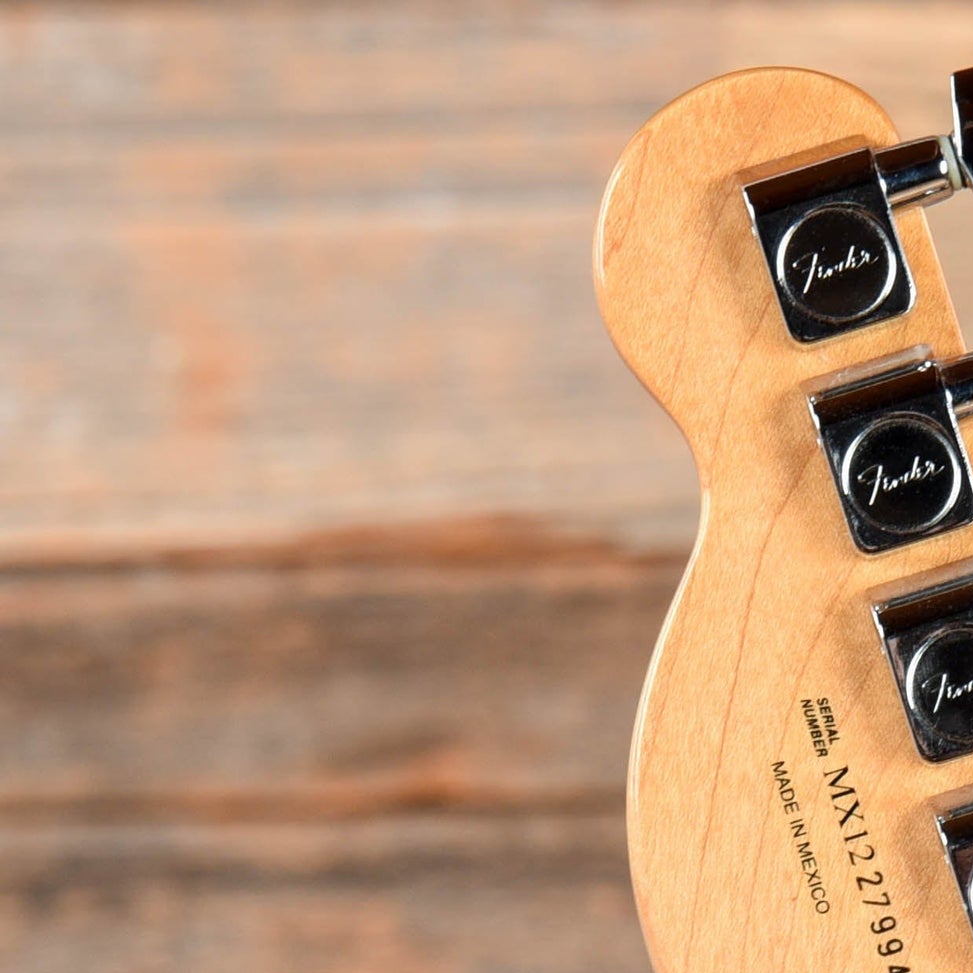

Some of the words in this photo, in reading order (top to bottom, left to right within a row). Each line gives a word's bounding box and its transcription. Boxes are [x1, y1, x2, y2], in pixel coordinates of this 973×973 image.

[793, 245, 880, 295] Fender
[858, 455, 946, 506] Fender
[800, 699, 829, 758] NUMBER
[816, 697, 841, 746] SERIAL
[771, 761, 799, 815] MADE
[790, 818, 807, 839] IN
[797, 841, 830, 914] MEXICO
